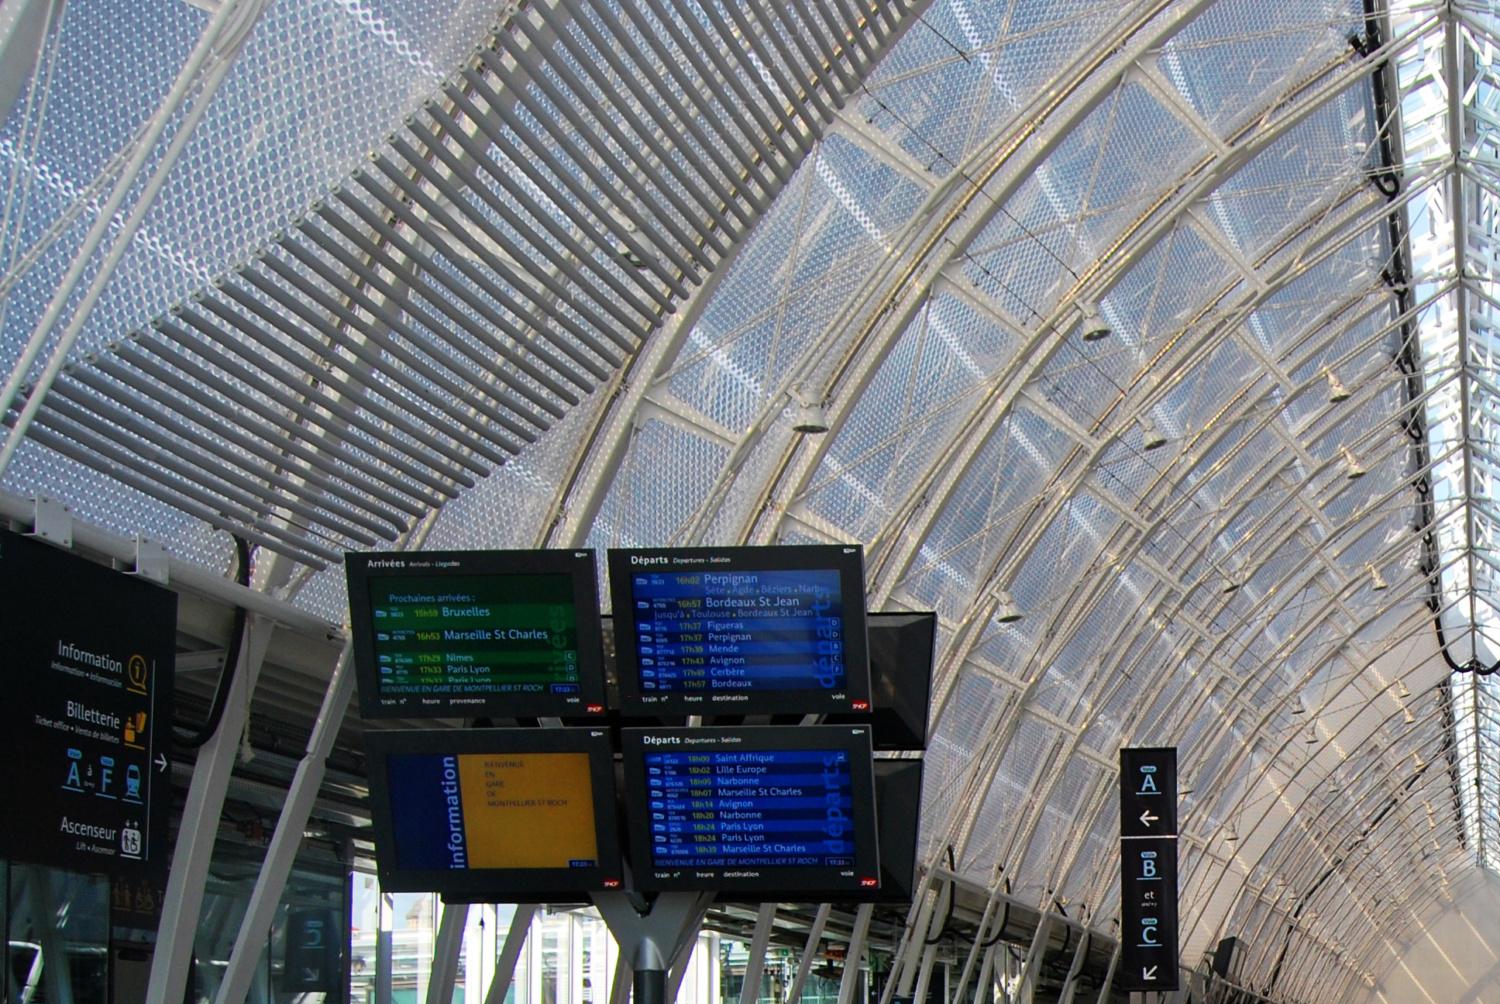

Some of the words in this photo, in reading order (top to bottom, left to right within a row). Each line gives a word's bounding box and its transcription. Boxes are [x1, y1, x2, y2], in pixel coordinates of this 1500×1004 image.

[367, 559, 406, 568] Arrivées
[631, 556, 669, 566] Départs
[704, 574, 758, 586] Perpignan
[705, 597, 756, 608] Bordeaux
[759, 596, 771, 607] St
[773, 596, 800, 607] Jean
[442, 606, 491, 618] Bruxelles
[707, 621, 744, 632] Figueras
[444, 629, 492, 641] Marseille
[494, 629, 507, 640] St
[508, 629, 549, 640] Charles
[708, 632, 752, 643] Perpignan
[709, 644, 740, 653] Mende
[58, 639, 124, 674] Information
[710, 656, 745, 666] Avignon
[446, 665, 468, 674] Paris
[469, 665, 491, 675] Lyon
[710, 667, 745, 677] Cerbère
[711, 679, 753, 688] Bordeaux
[449, 698, 486, 706] provenance
[65, 699, 121, 731] Billetterie
[643, 736, 681, 746] Départs
[715, 753, 737, 762] Saint
[739, 753, 775, 764] Affrique
[716, 765, 735, 774] Lille
[736, 764, 767, 775] Europe
[66, 760, 82, 788] A
[101, 767, 114, 793] F
[717, 777, 760, 785] Narbonne
[1141, 773, 1157, 792] A
[718, 788, 757, 797] Marseille
[759, 787, 768, 796] St
[770, 787, 803, 796] Charles
[719, 799, 754, 810] Avignon
[439, 756, 467, 870] information
[719, 810, 763, 820] Narbonne
[60, 815, 117, 842] Ascenseur
[720, 822, 742, 831] Paris
[743, 822, 764, 832] Lyon
[721, 833, 743, 842] Paris
[744, 833, 765, 843] Lyon
[722, 844, 761, 853] Marseille
[763, 843, 772, 852] St
[774, 843, 806, 852] Charles
[1143, 859, 1157, 877] B
[723, 870, 760, 878] destination
[1144, 891, 1155, 900] et
[1142, 925, 1157, 944] C
